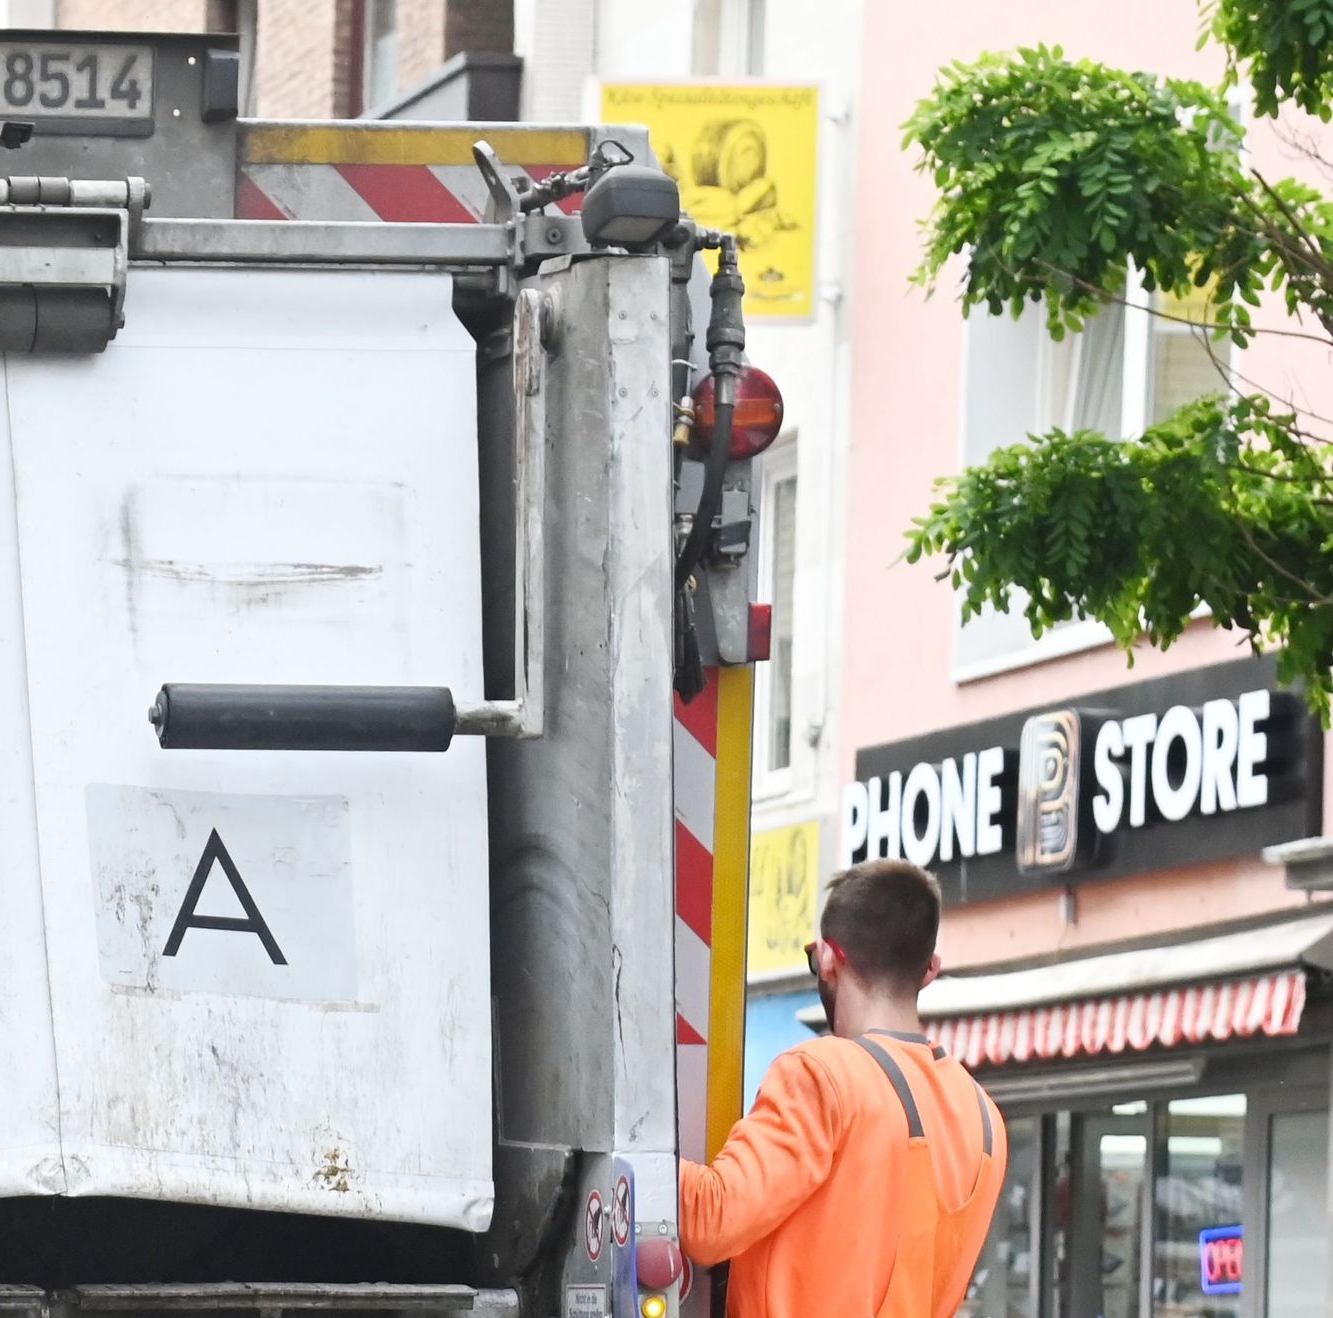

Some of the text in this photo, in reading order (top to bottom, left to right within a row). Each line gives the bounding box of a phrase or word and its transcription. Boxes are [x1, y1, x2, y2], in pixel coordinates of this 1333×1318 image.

[4, 52, 143, 111] 8514
[843, 745, 1005, 868] PHONE
[1092, 690, 1271, 834] STORE
[161, 827, 289, 965] A
